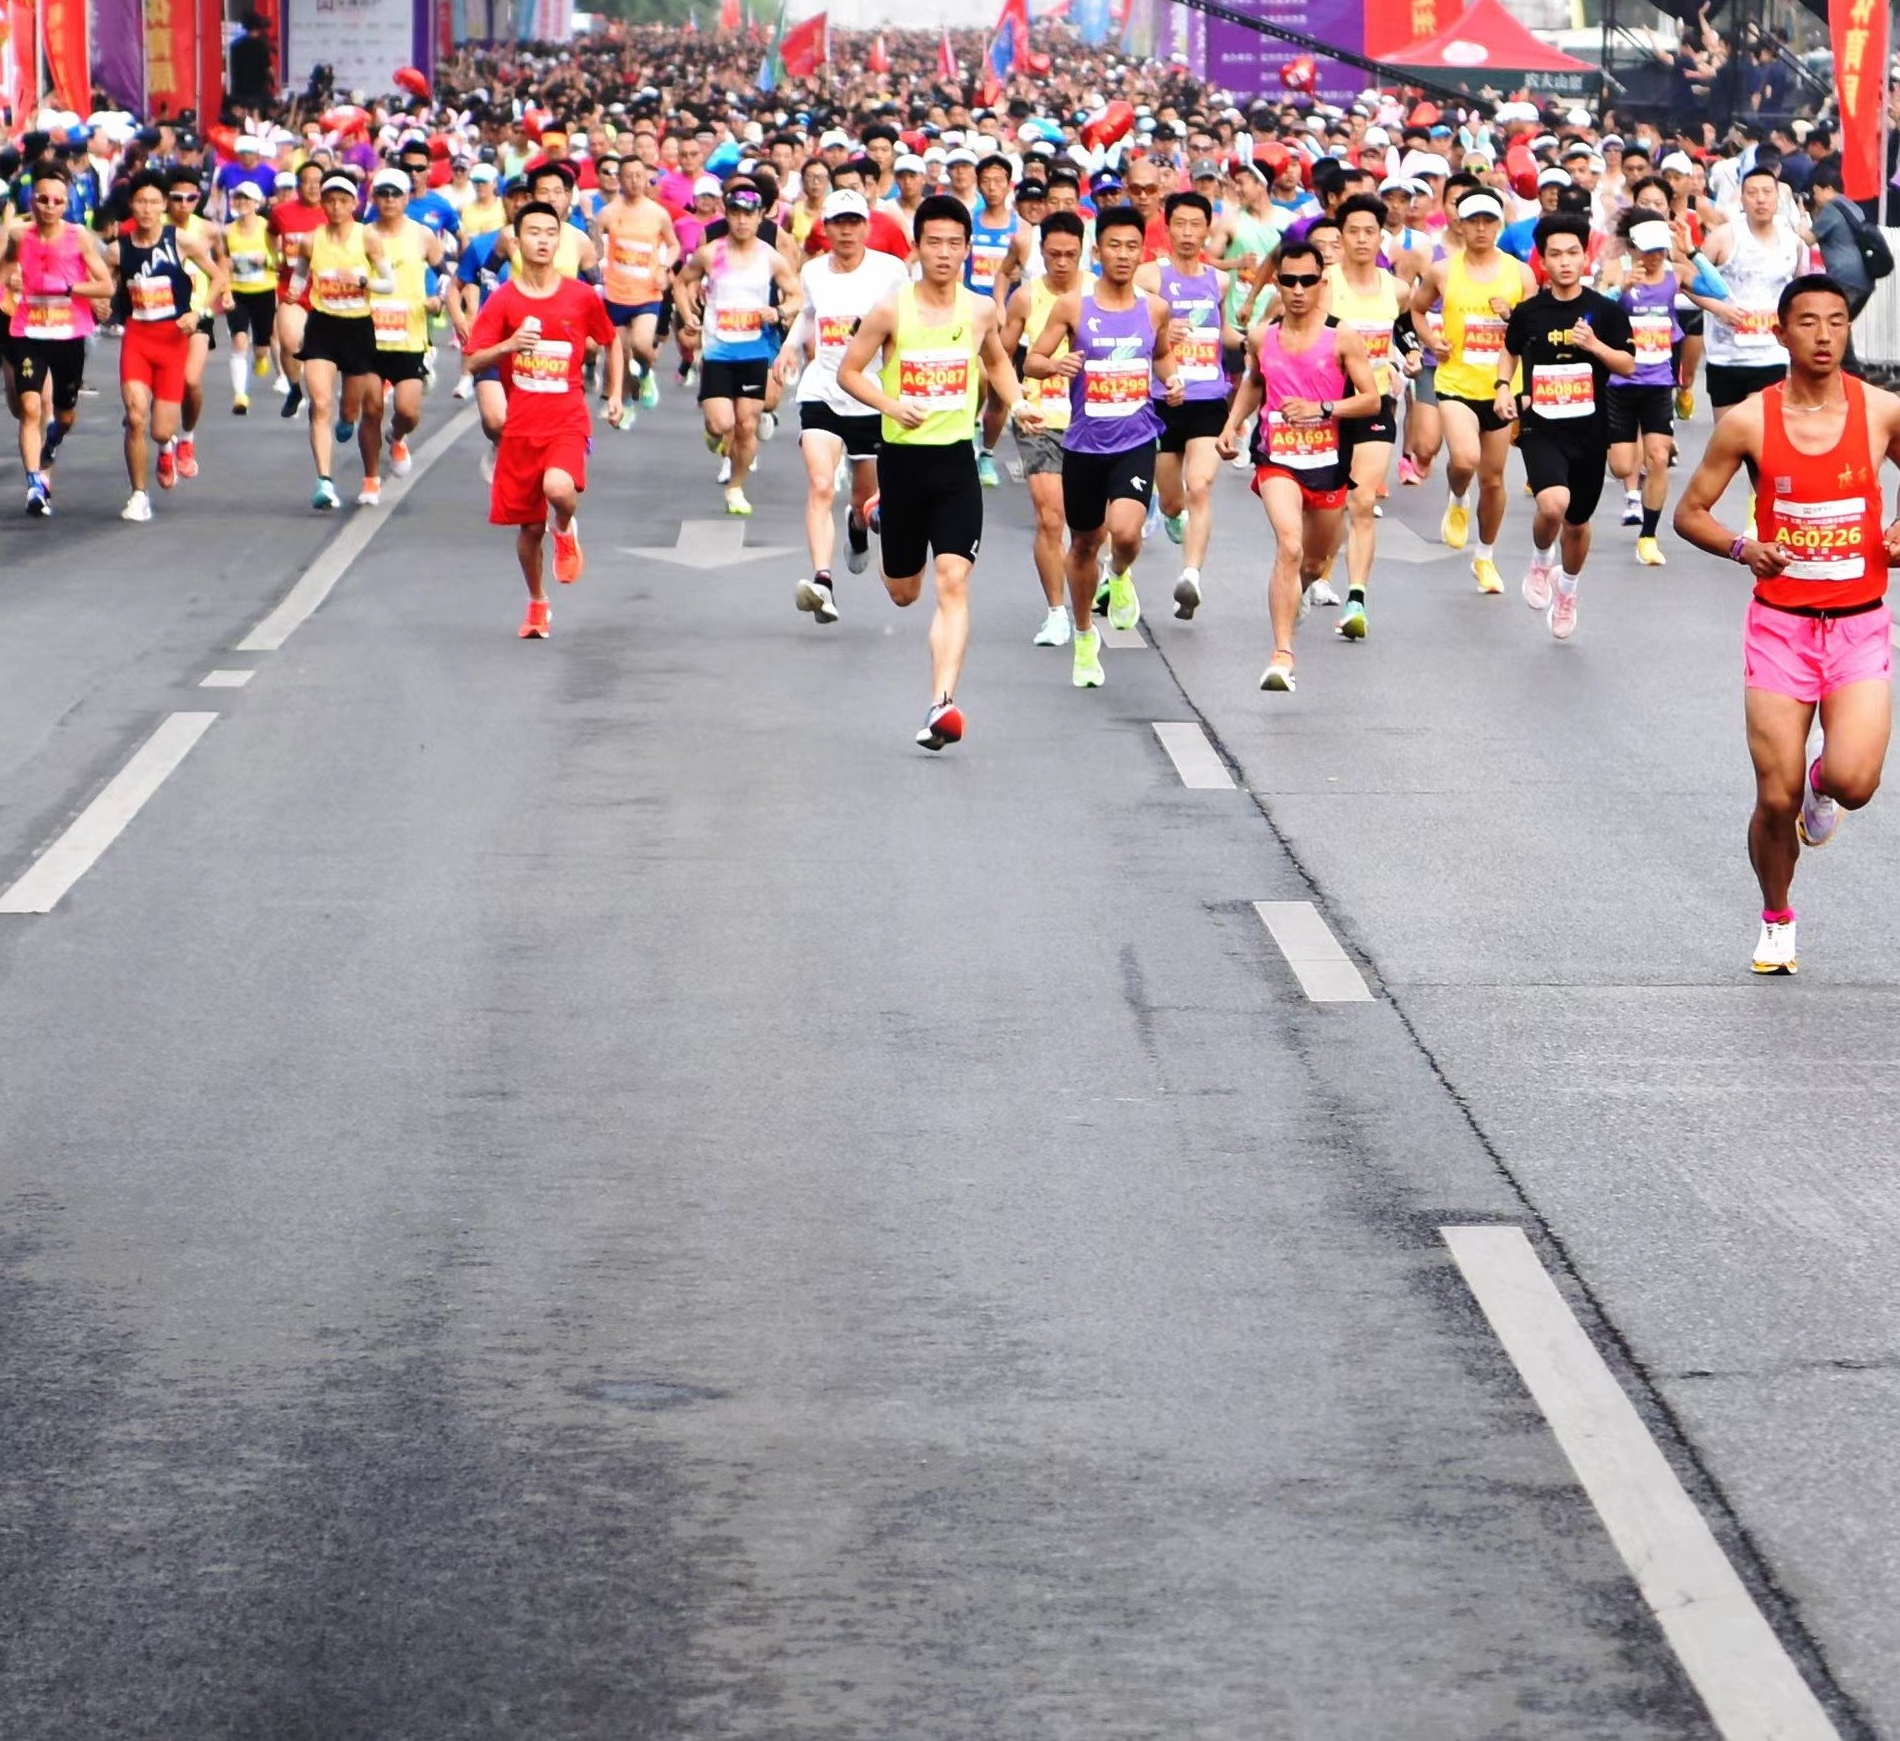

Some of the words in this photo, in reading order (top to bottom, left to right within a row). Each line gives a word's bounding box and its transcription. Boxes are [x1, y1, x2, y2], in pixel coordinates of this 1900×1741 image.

[1173, 344, 1215, 359] 60155
[903, 368, 965, 385] A62087
[1088, 378, 1148, 394] A61299
[1536, 381, 1591, 396] A60862
[1272, 429, 1334, 446] A61691
[1775, 526, 1861, 547] A60226
